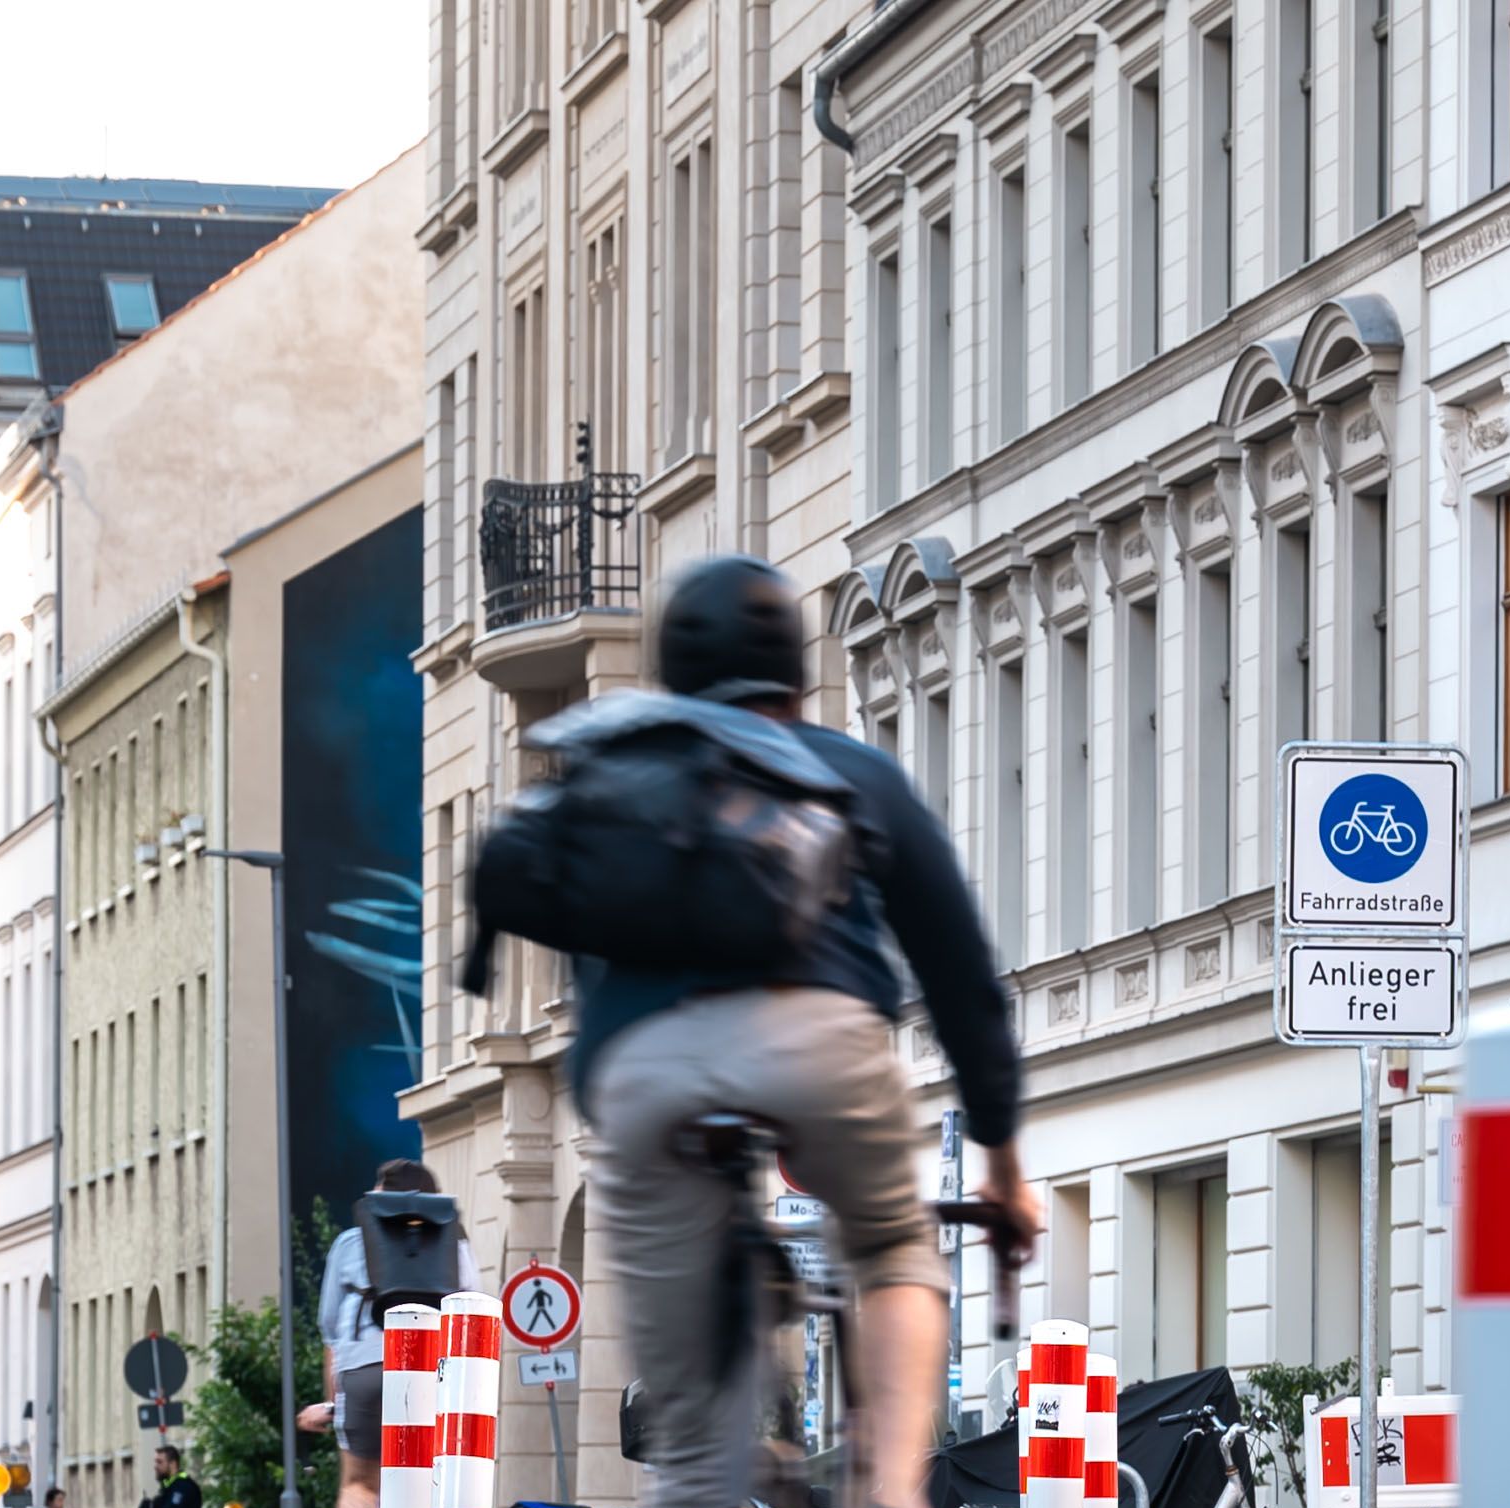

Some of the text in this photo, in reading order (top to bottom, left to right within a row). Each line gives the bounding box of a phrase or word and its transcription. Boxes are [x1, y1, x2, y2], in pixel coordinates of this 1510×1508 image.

[1300, 892, 1444, 912] Fahrradstraße
[1308, 960, 1436, 994] Anlieger
[1347, 995, 1397, 1021] frei
[789, 1203, 826, 1216] Mo-S
